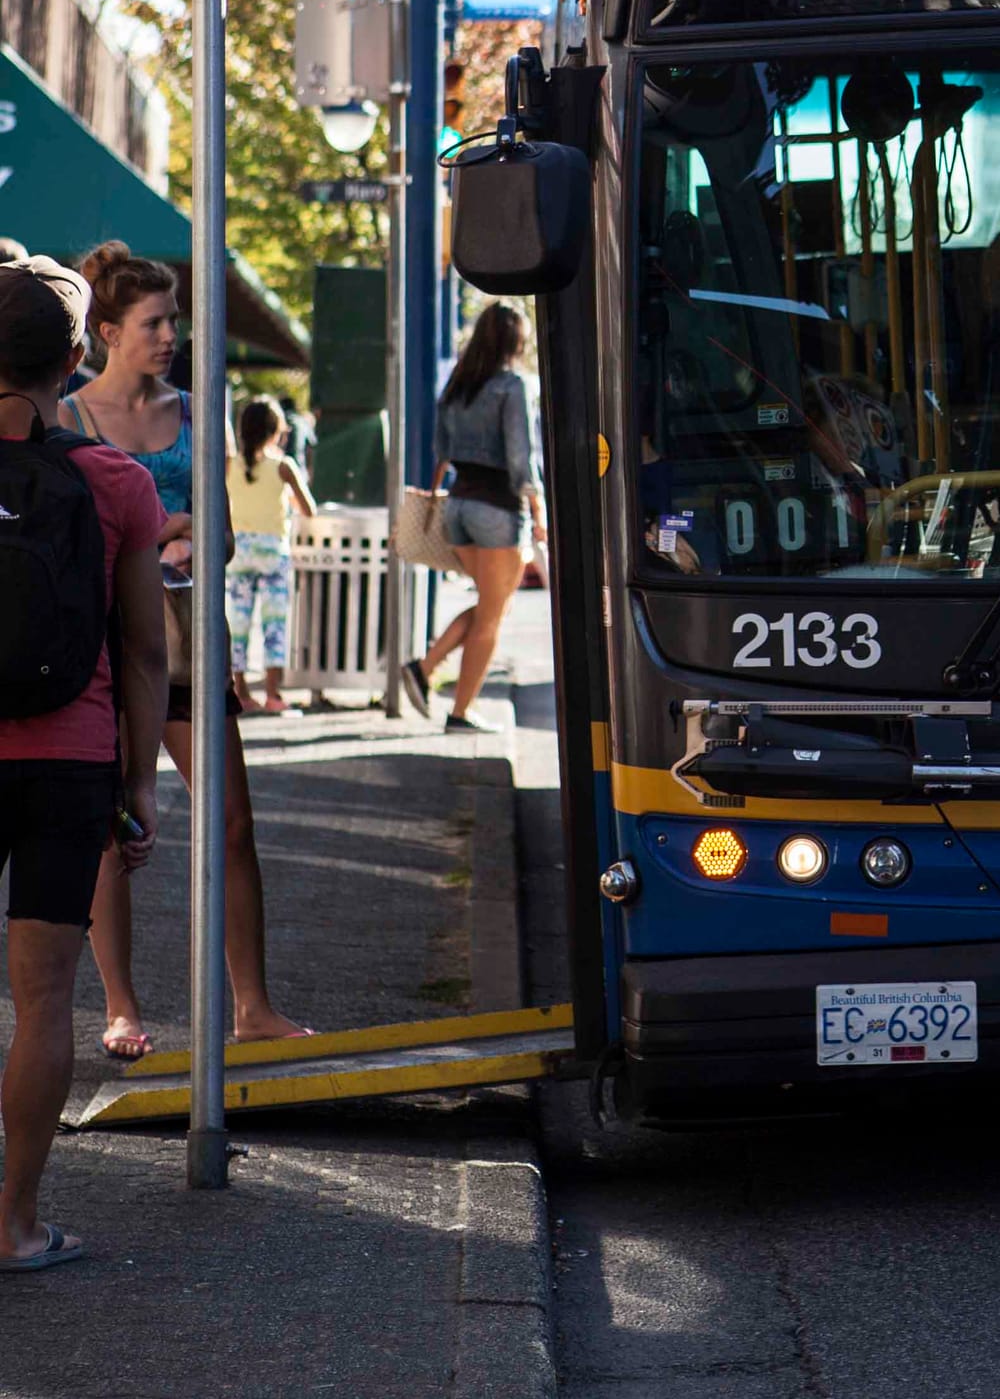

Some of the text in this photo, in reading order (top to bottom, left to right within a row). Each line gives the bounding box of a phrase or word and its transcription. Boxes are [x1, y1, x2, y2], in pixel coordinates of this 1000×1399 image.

[731, 611, 882, 669] 2133
[831, 992, 963, 1006] Beautiful British Columbia
[887, 1004, 972, 1043] 6392
[873, 1048, 883, 1057] 31
